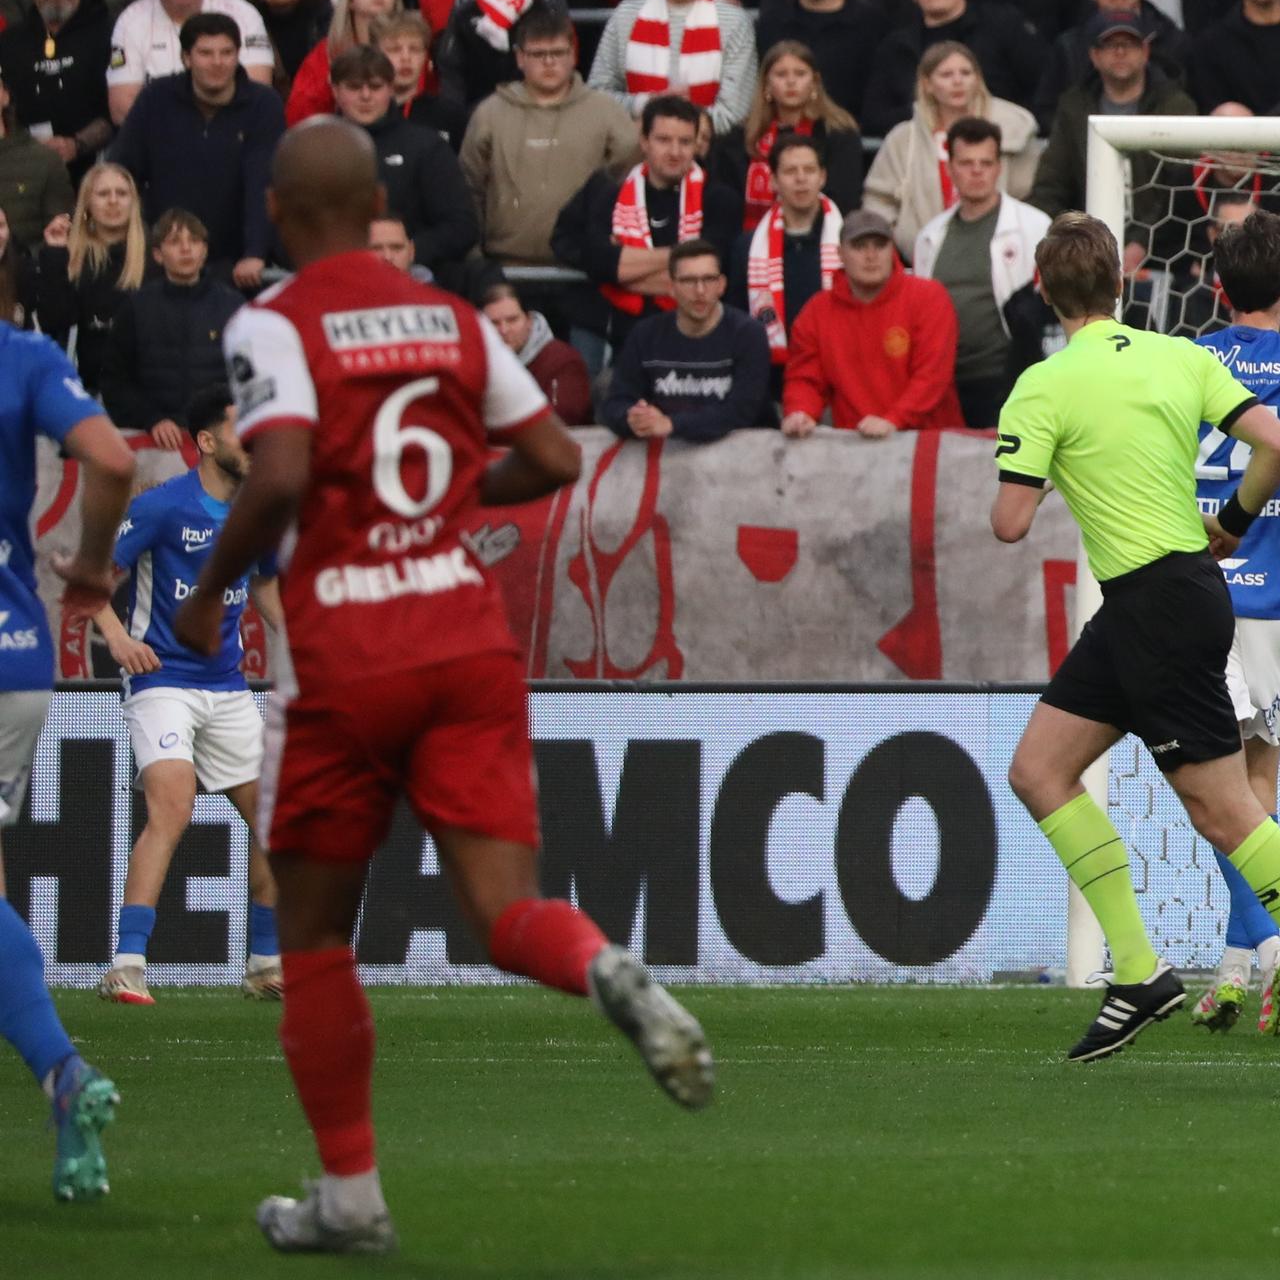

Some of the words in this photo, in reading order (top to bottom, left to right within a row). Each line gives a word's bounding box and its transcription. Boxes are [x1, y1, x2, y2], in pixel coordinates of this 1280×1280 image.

[326, 308, 452, 344] HEYLEN
[372, 376, 452, 518] 6
[1223, 572, 1268, 586] LASS
[0, 730, 998, 968] HEAMCO
